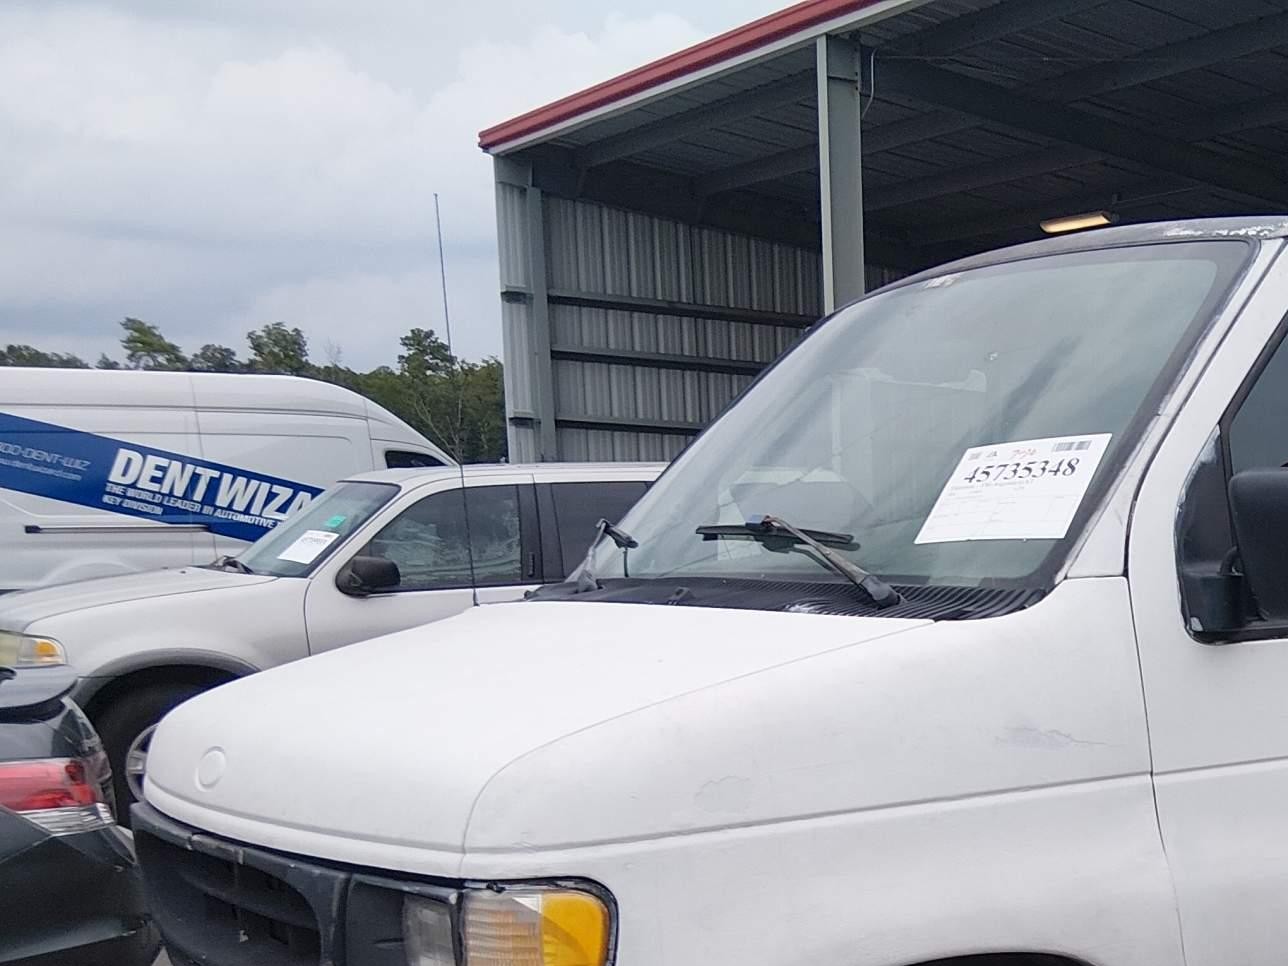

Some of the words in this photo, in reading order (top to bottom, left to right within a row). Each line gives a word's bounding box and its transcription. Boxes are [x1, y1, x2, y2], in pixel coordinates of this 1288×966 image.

[108, 447, 220, 502] DENT
[963, 457, 1080, 484] 45735348
[102, 494, 121, 505] KEY
[121, 499, 164, 515] DIVISION
[105, 482, 127, 495] THE
[126, 487, 162, 503] WORLD
[162, 496, 202, 512] LEADER
[201, 505, 214, 515] IN
[213, 507, 276, 529] AUTOMOTIVE
